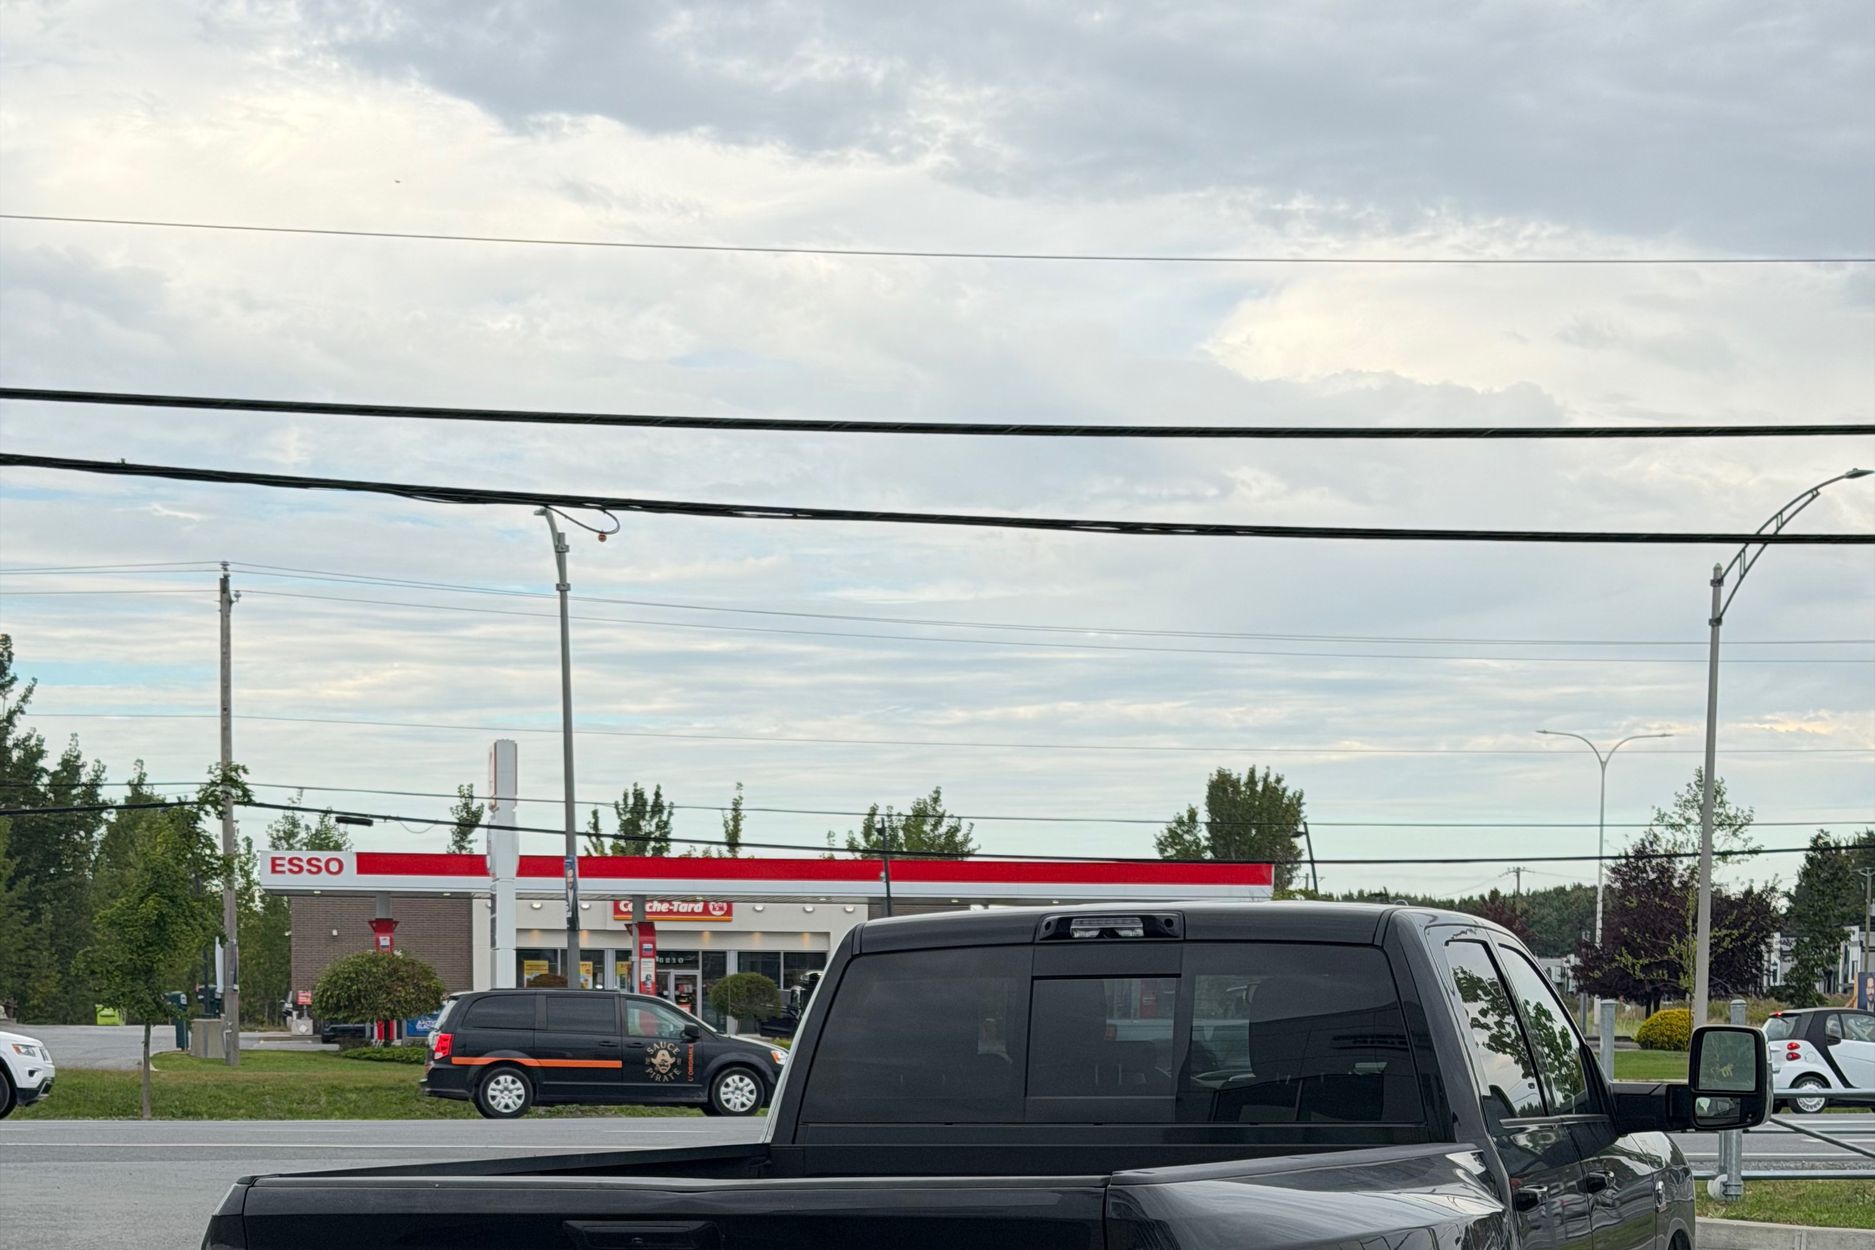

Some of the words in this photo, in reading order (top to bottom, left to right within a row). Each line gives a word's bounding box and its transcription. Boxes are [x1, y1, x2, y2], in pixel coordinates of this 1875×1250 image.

[270, 856, 344, 876] ESSO
[619, 900, 705, 913] Coche-Tard
[646, 1041, 681, 1055] SAUCE
[645, 1067, 682, 1082] PIRATE
